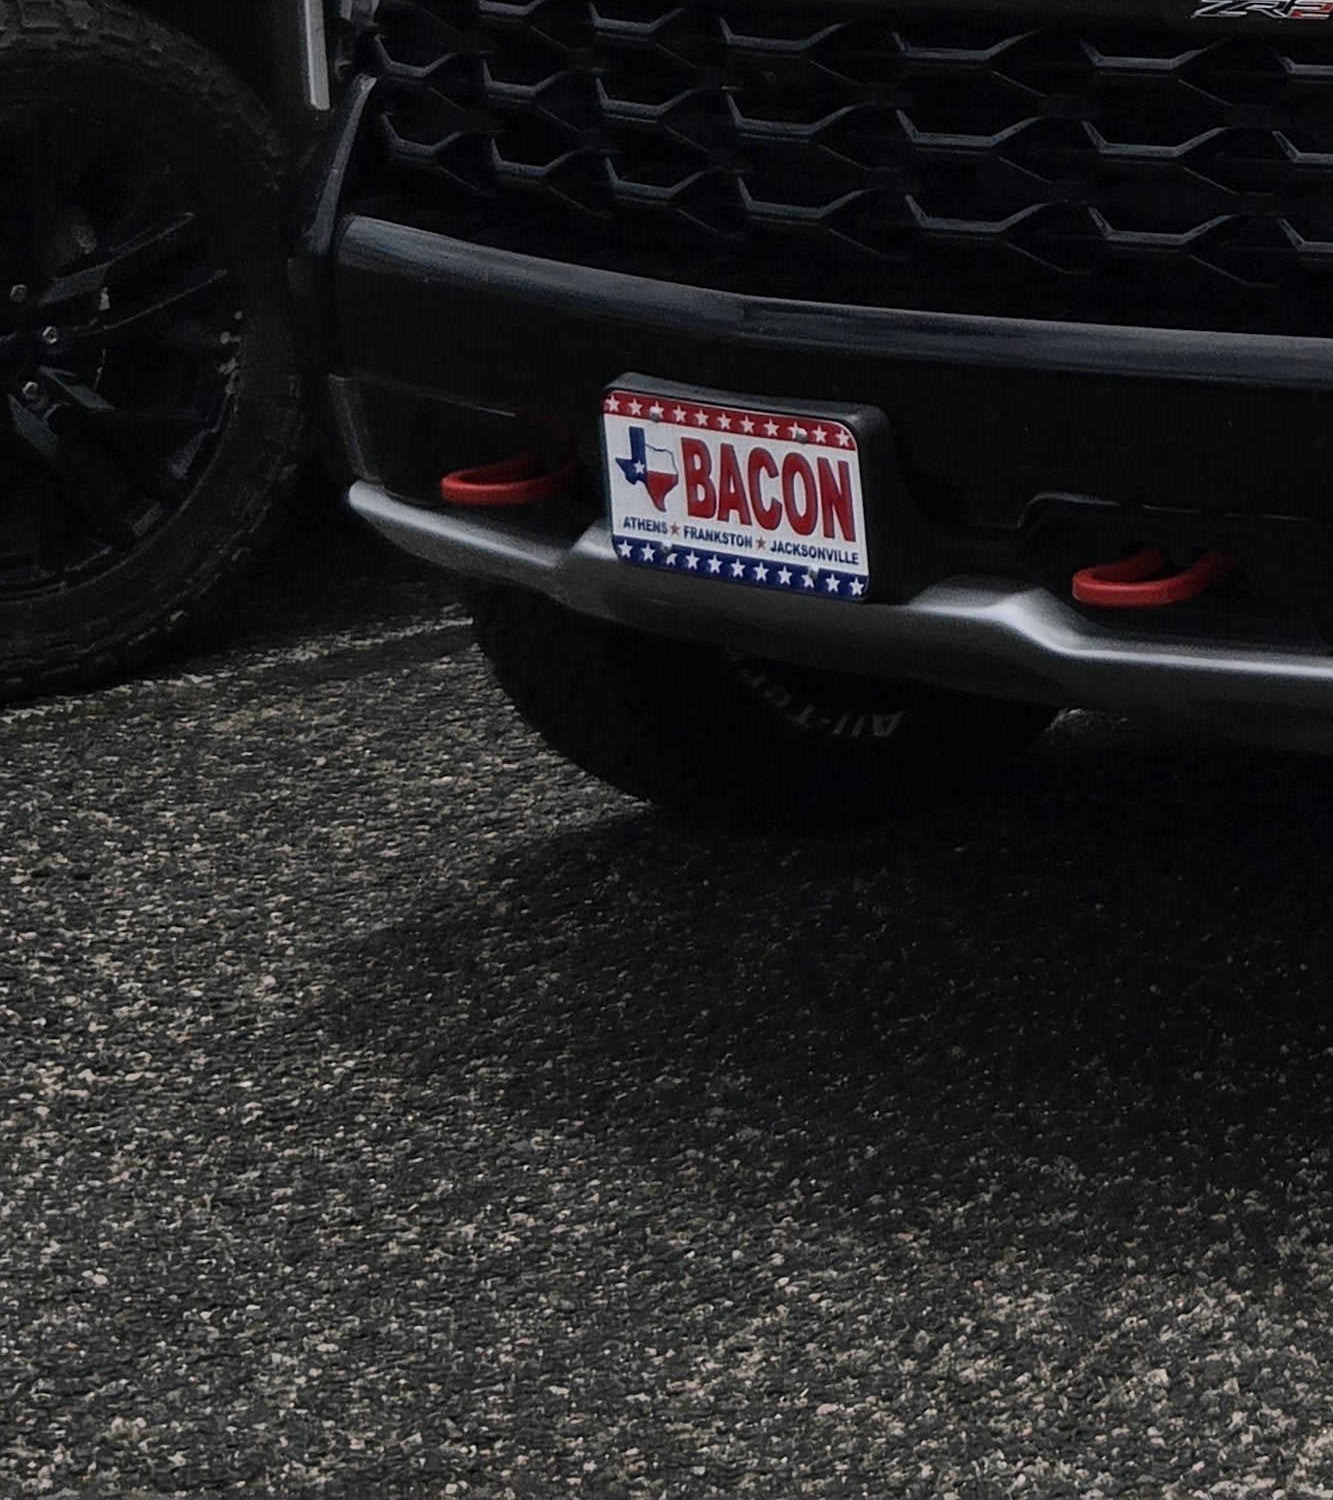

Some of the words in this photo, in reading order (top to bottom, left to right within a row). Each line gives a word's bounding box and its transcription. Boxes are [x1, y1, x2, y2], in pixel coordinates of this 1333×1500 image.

[681, 437, 856, 542] BACON
[622, 516, 668, 535] ATHENS
[683, 525, 753, 548] FRANKSTON
[770, 539, 860, 565] JACKSONVILLE
